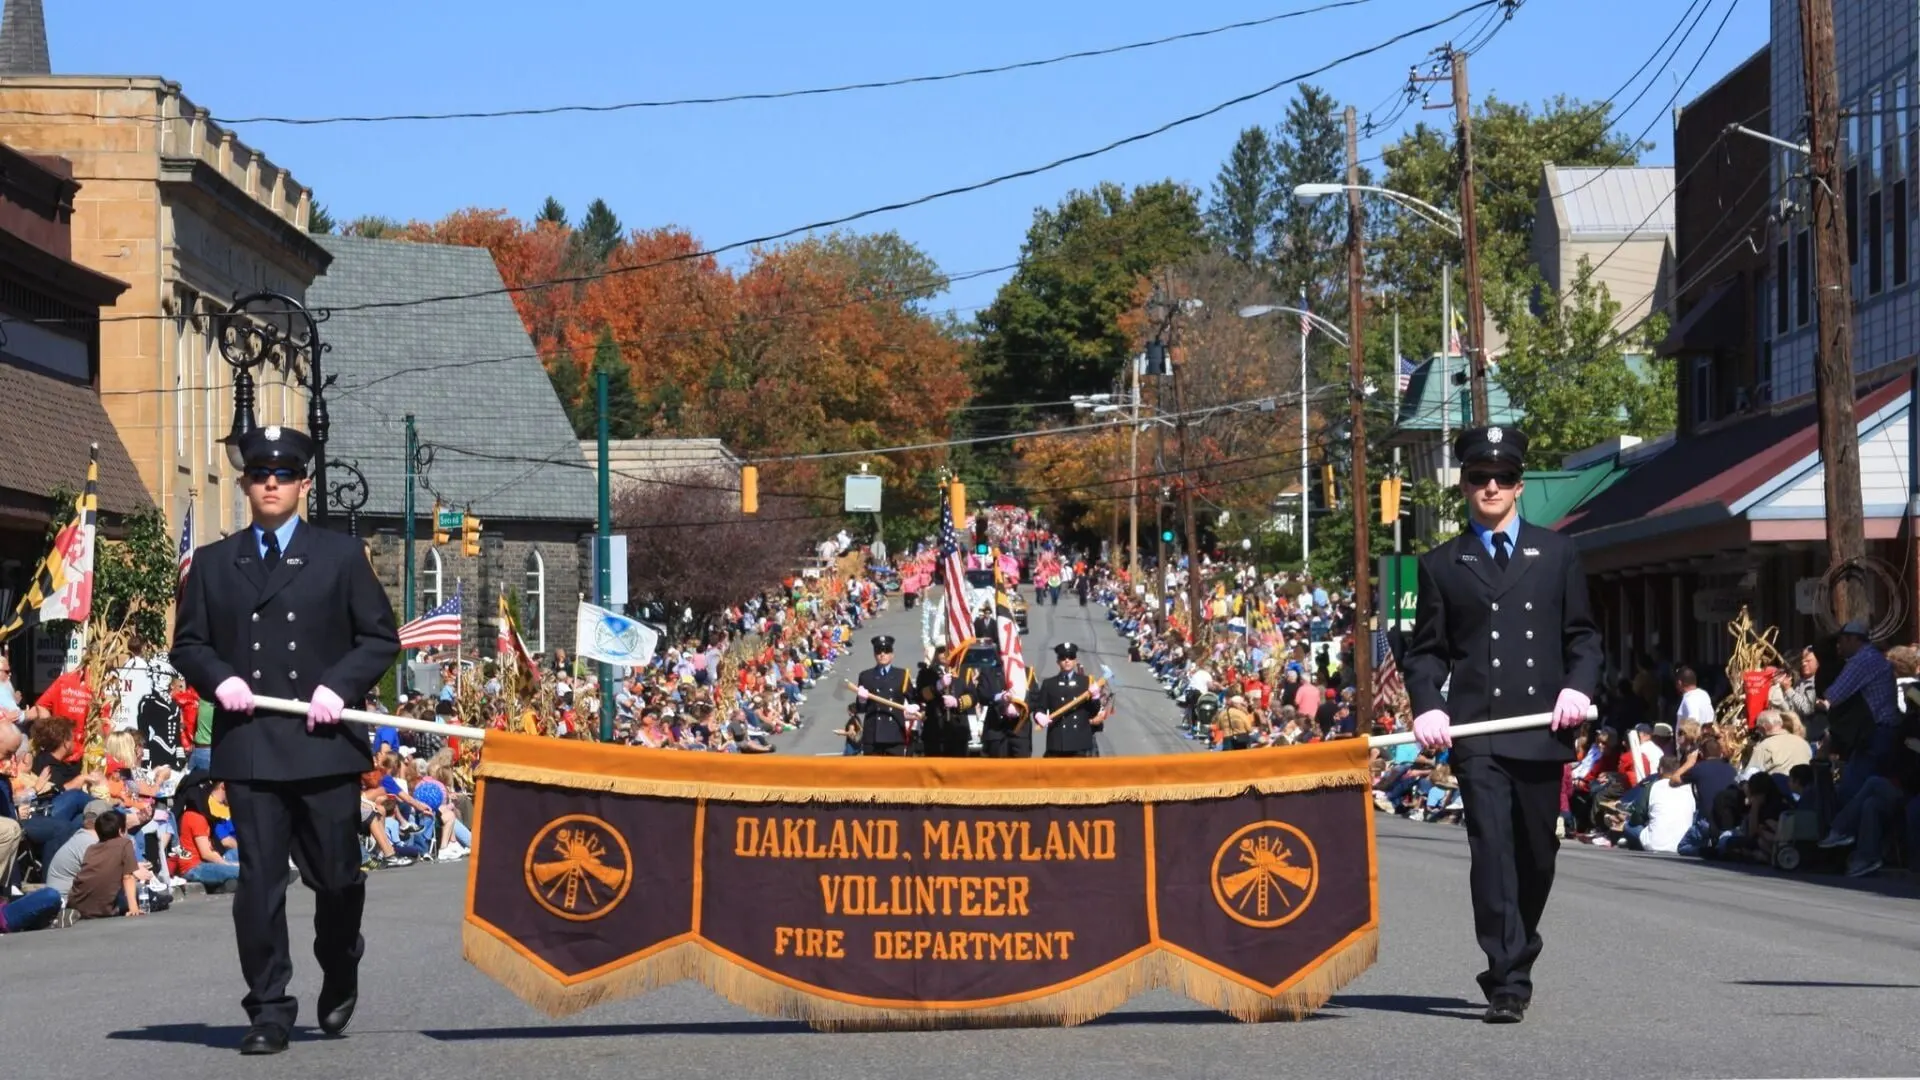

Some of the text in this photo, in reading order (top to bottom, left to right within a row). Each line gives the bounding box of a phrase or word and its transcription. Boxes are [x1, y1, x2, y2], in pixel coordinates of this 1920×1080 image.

[735, 817, 1116, 862] OAKLAND, MARYLAND
[820, 875, 1030, 917] VOLUNTEER
[775, 927, 1075, 961] FIRE DEPARTMENT
